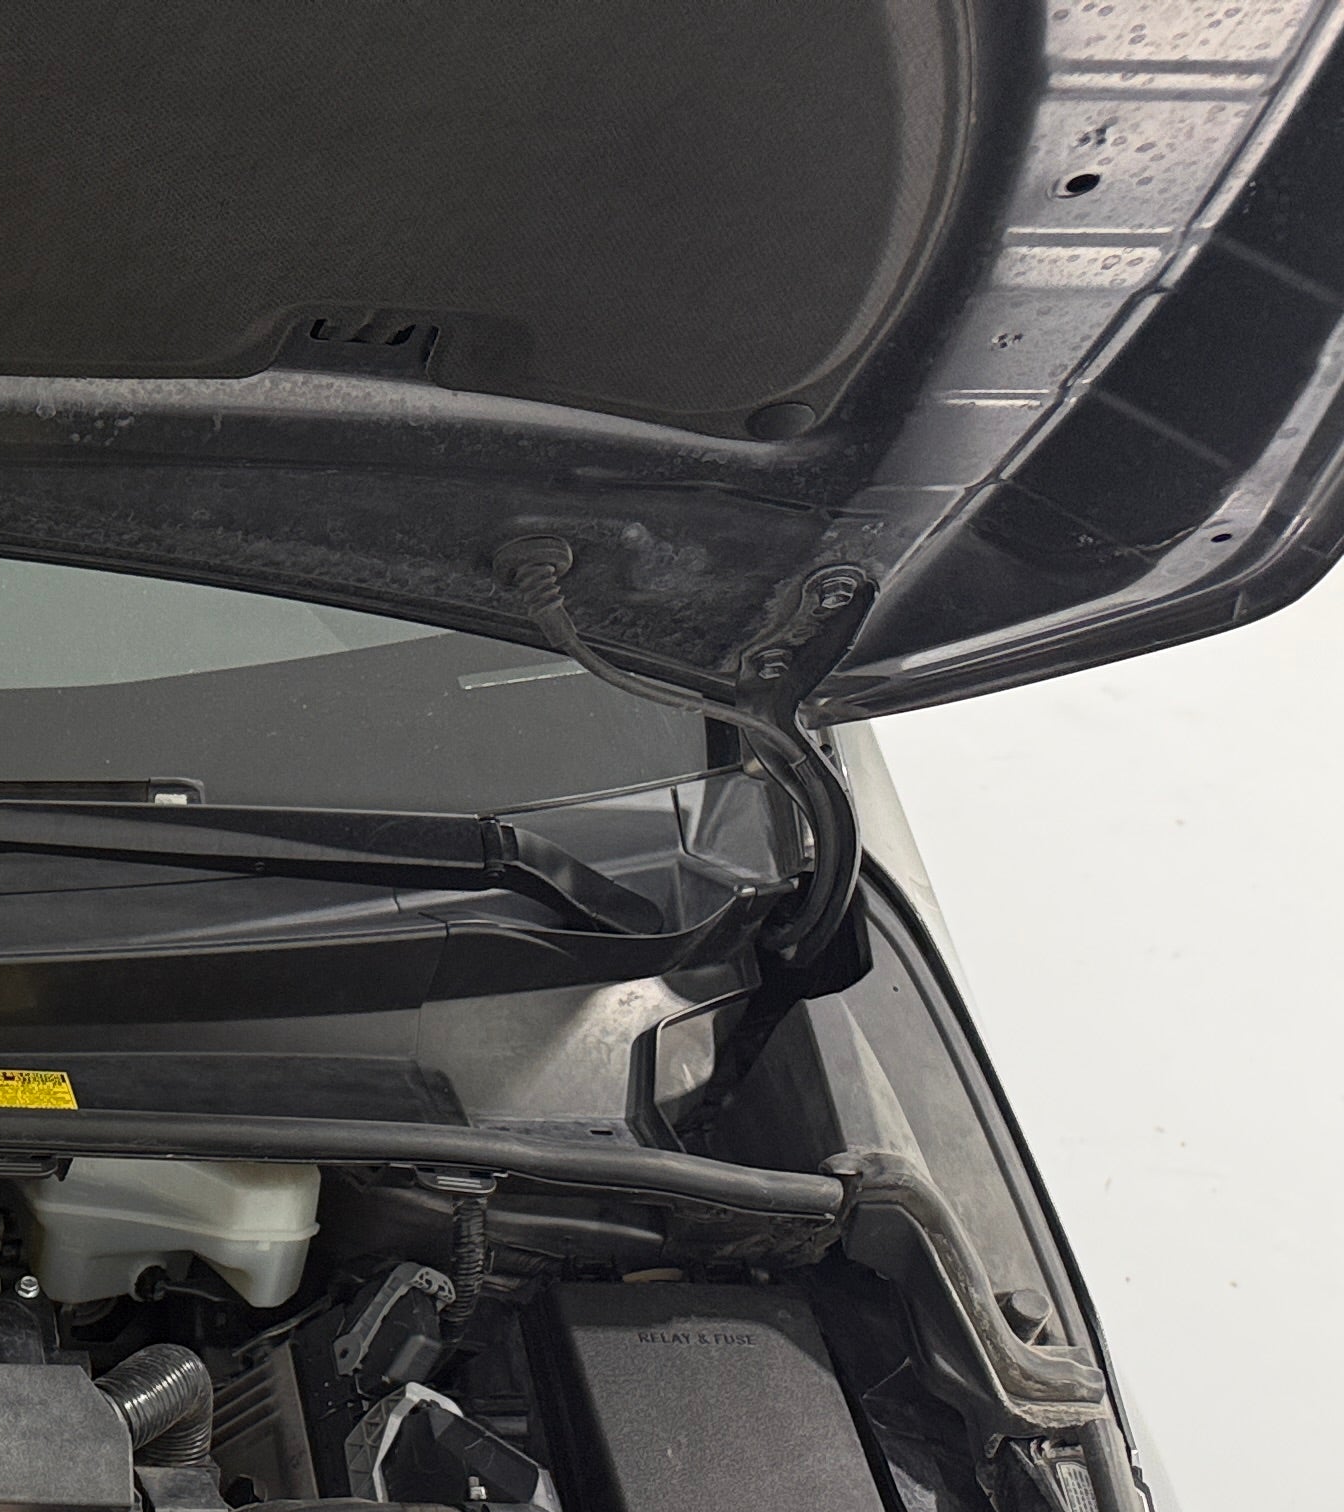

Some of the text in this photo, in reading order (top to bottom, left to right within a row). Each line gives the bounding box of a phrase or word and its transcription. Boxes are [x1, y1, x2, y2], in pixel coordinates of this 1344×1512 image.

[638, 1332, 757, 1346] RELAY & FUSE
